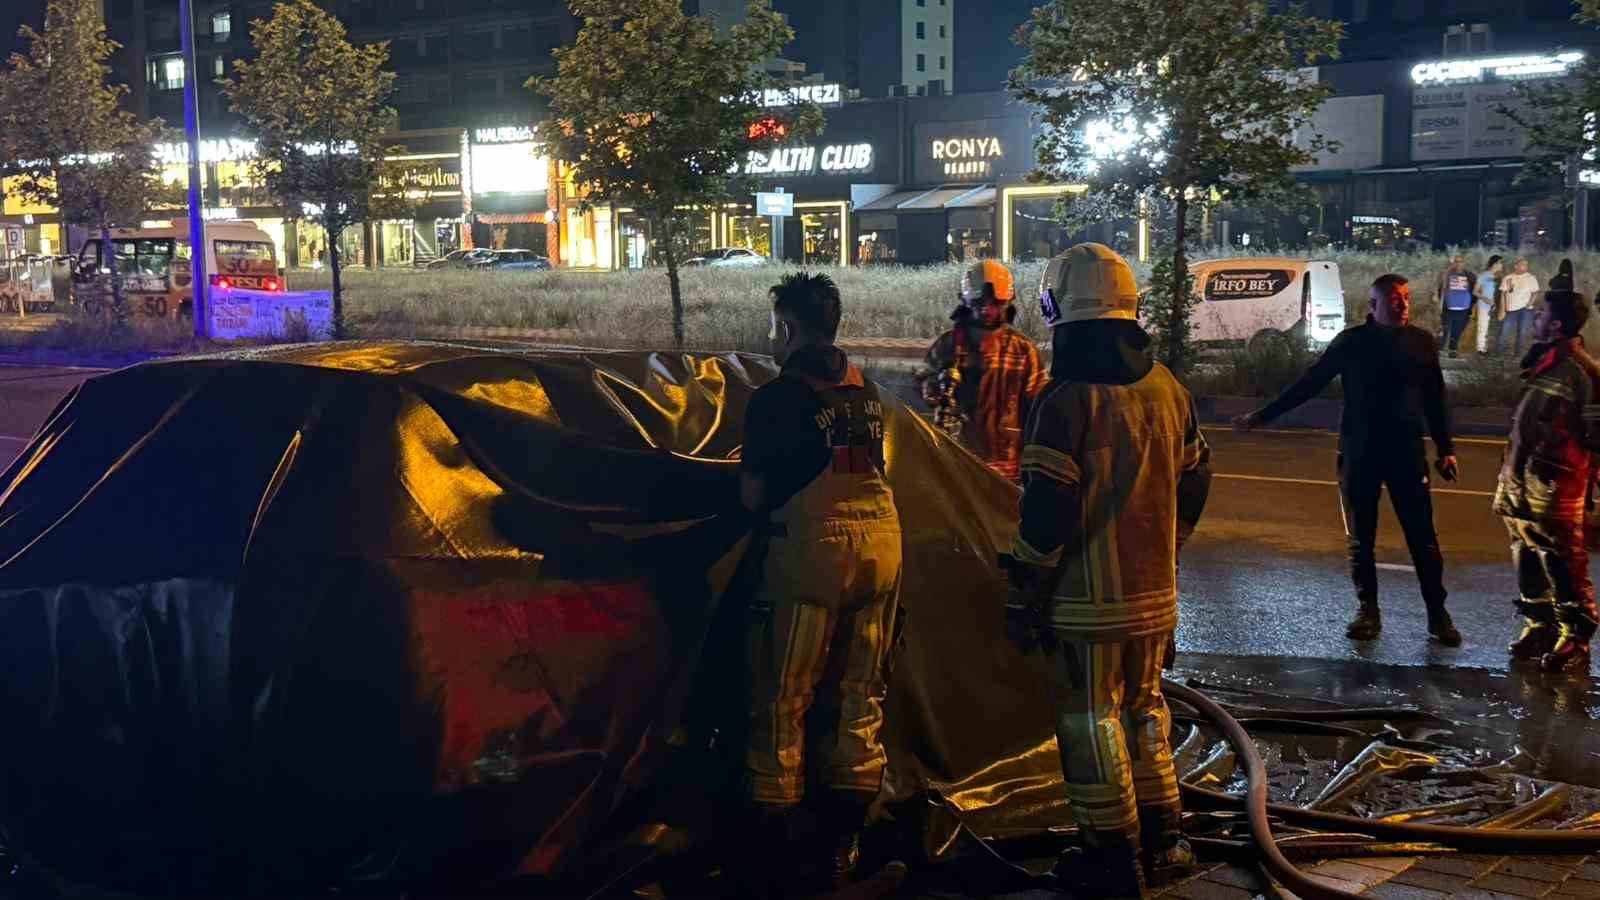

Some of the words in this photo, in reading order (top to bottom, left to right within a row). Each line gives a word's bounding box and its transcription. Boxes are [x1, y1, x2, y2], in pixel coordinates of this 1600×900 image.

[1420, 116, 1459, 128] EPSON
[932, 137, 1001, 159] RONYA
[821, 144, 872, 170] CLUB
[1248, 279, 1279, 291] BEY
